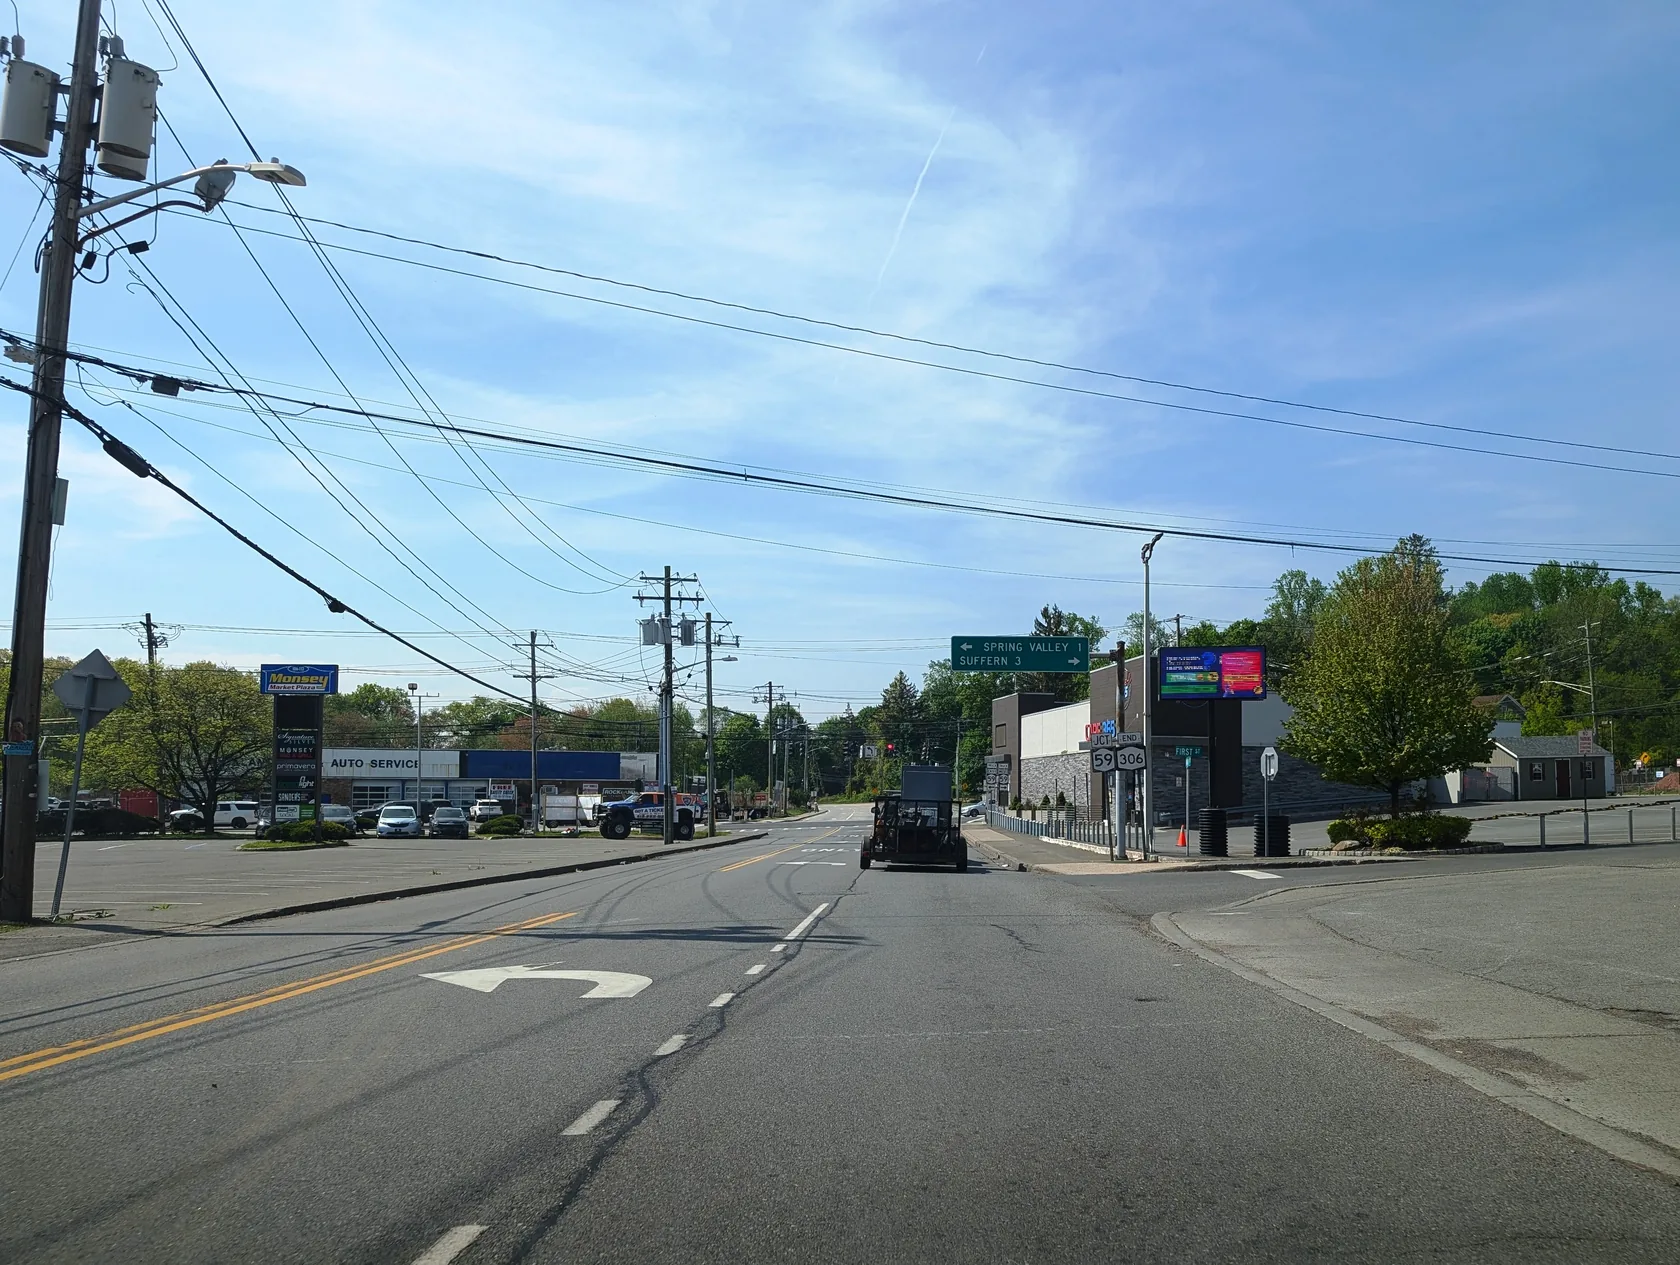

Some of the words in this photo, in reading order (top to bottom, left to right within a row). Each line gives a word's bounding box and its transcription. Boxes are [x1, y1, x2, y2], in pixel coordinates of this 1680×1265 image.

[983, 642, 1023, 652] SPRING
[1029, 642, 1069, 652] VALLEY
[1078, 642, 1082, 652] 1
[959, 656, 1008, 666] SUFFERN
[1014, 656, 1022, 666] 3
[269, 673, 329, 689] Monsey
[1093, 735, 1110, 746] JCT
[1122, 734, 1137, 742] END
[1175, 747, 1193, 756] FIRST
[331, 759, 364, 768] AUTO
[1094, 753, 1113, 767] 59
[1119, 753, 1144, 765] 306
